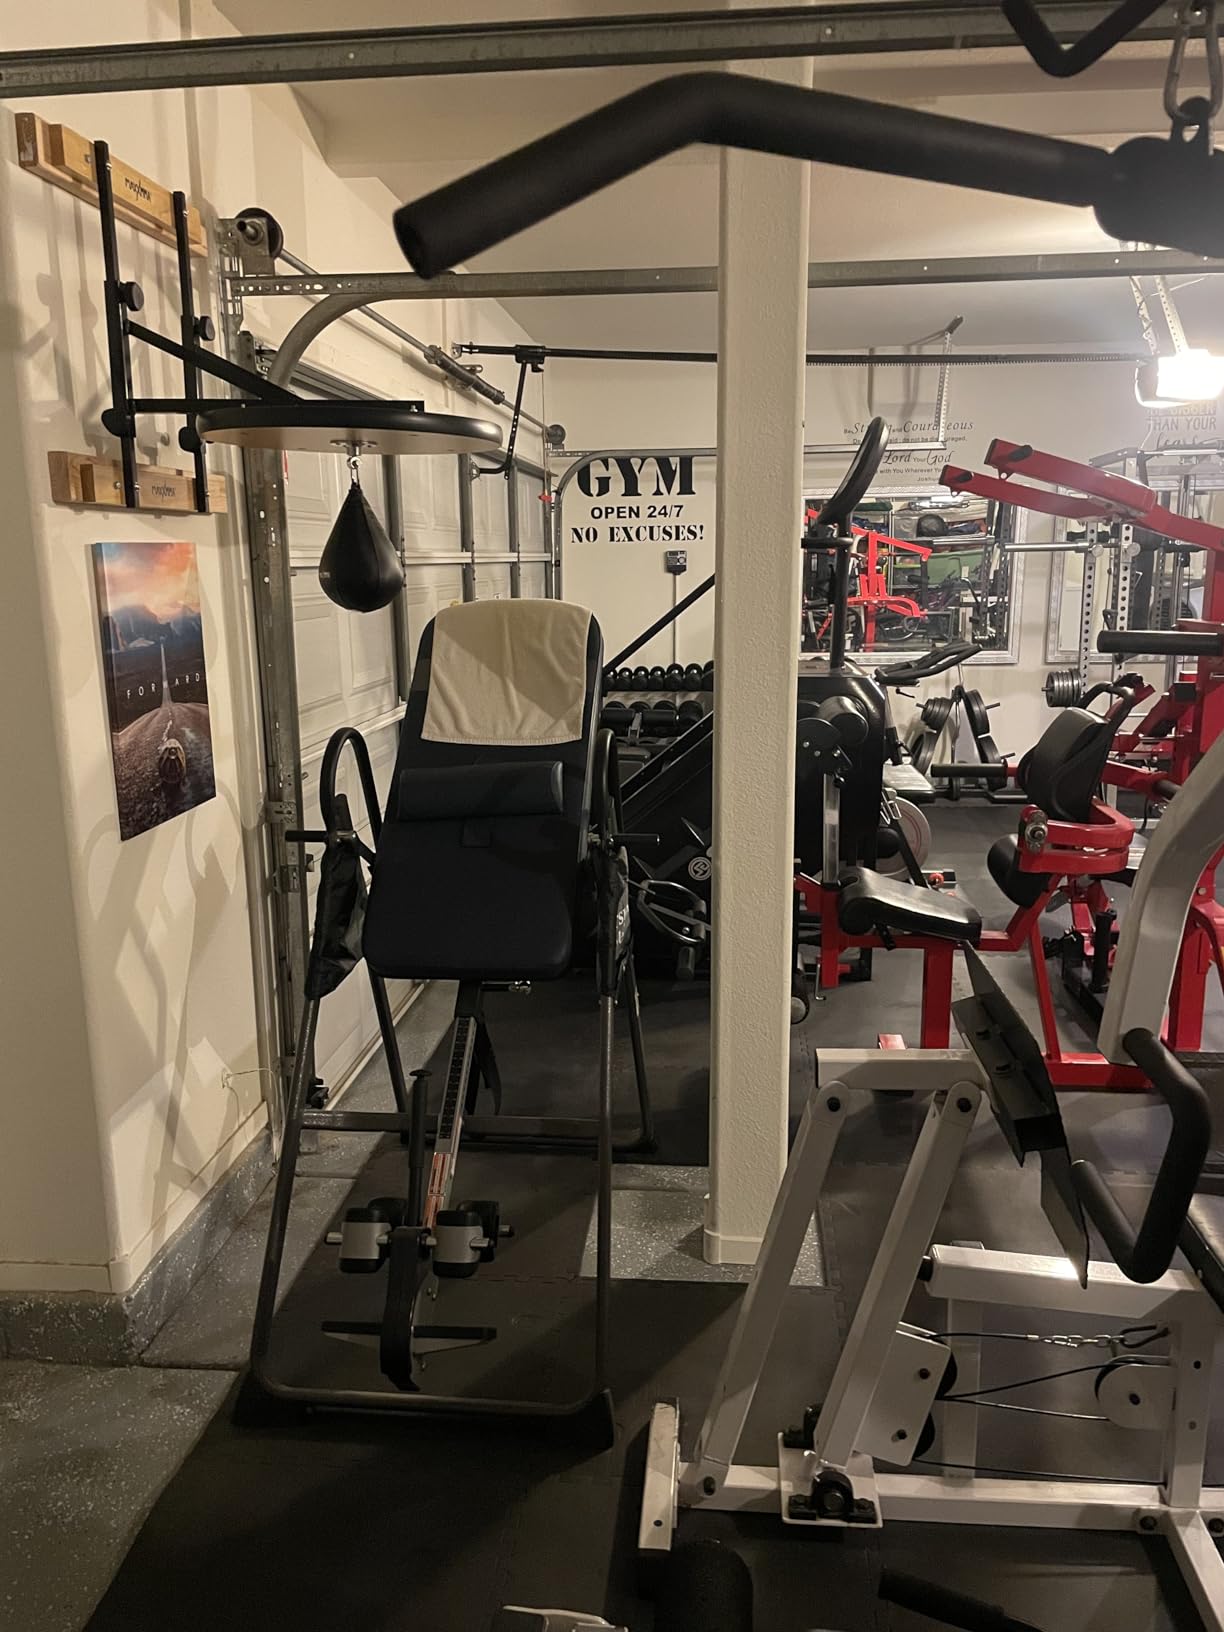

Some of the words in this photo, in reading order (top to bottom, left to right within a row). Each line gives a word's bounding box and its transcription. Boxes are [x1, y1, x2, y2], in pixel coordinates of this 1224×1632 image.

[903, 420, 974, 433] Couraeous
[1186, 416, 1217, 431] YOUR
[882, 450, 912, 465] Lord
[926, 449, 956, 466] God
[577, 456, 696, 498] GYM
[879, 466, 892, 474] with
[892, 466, 904, 474] You
[590, 506, 641, 520] OPEN
[647, 504, 684, 519] 24/7
[570, 527, 598, 544] NO
[608, 524, 705, 543] EXCUSES!
